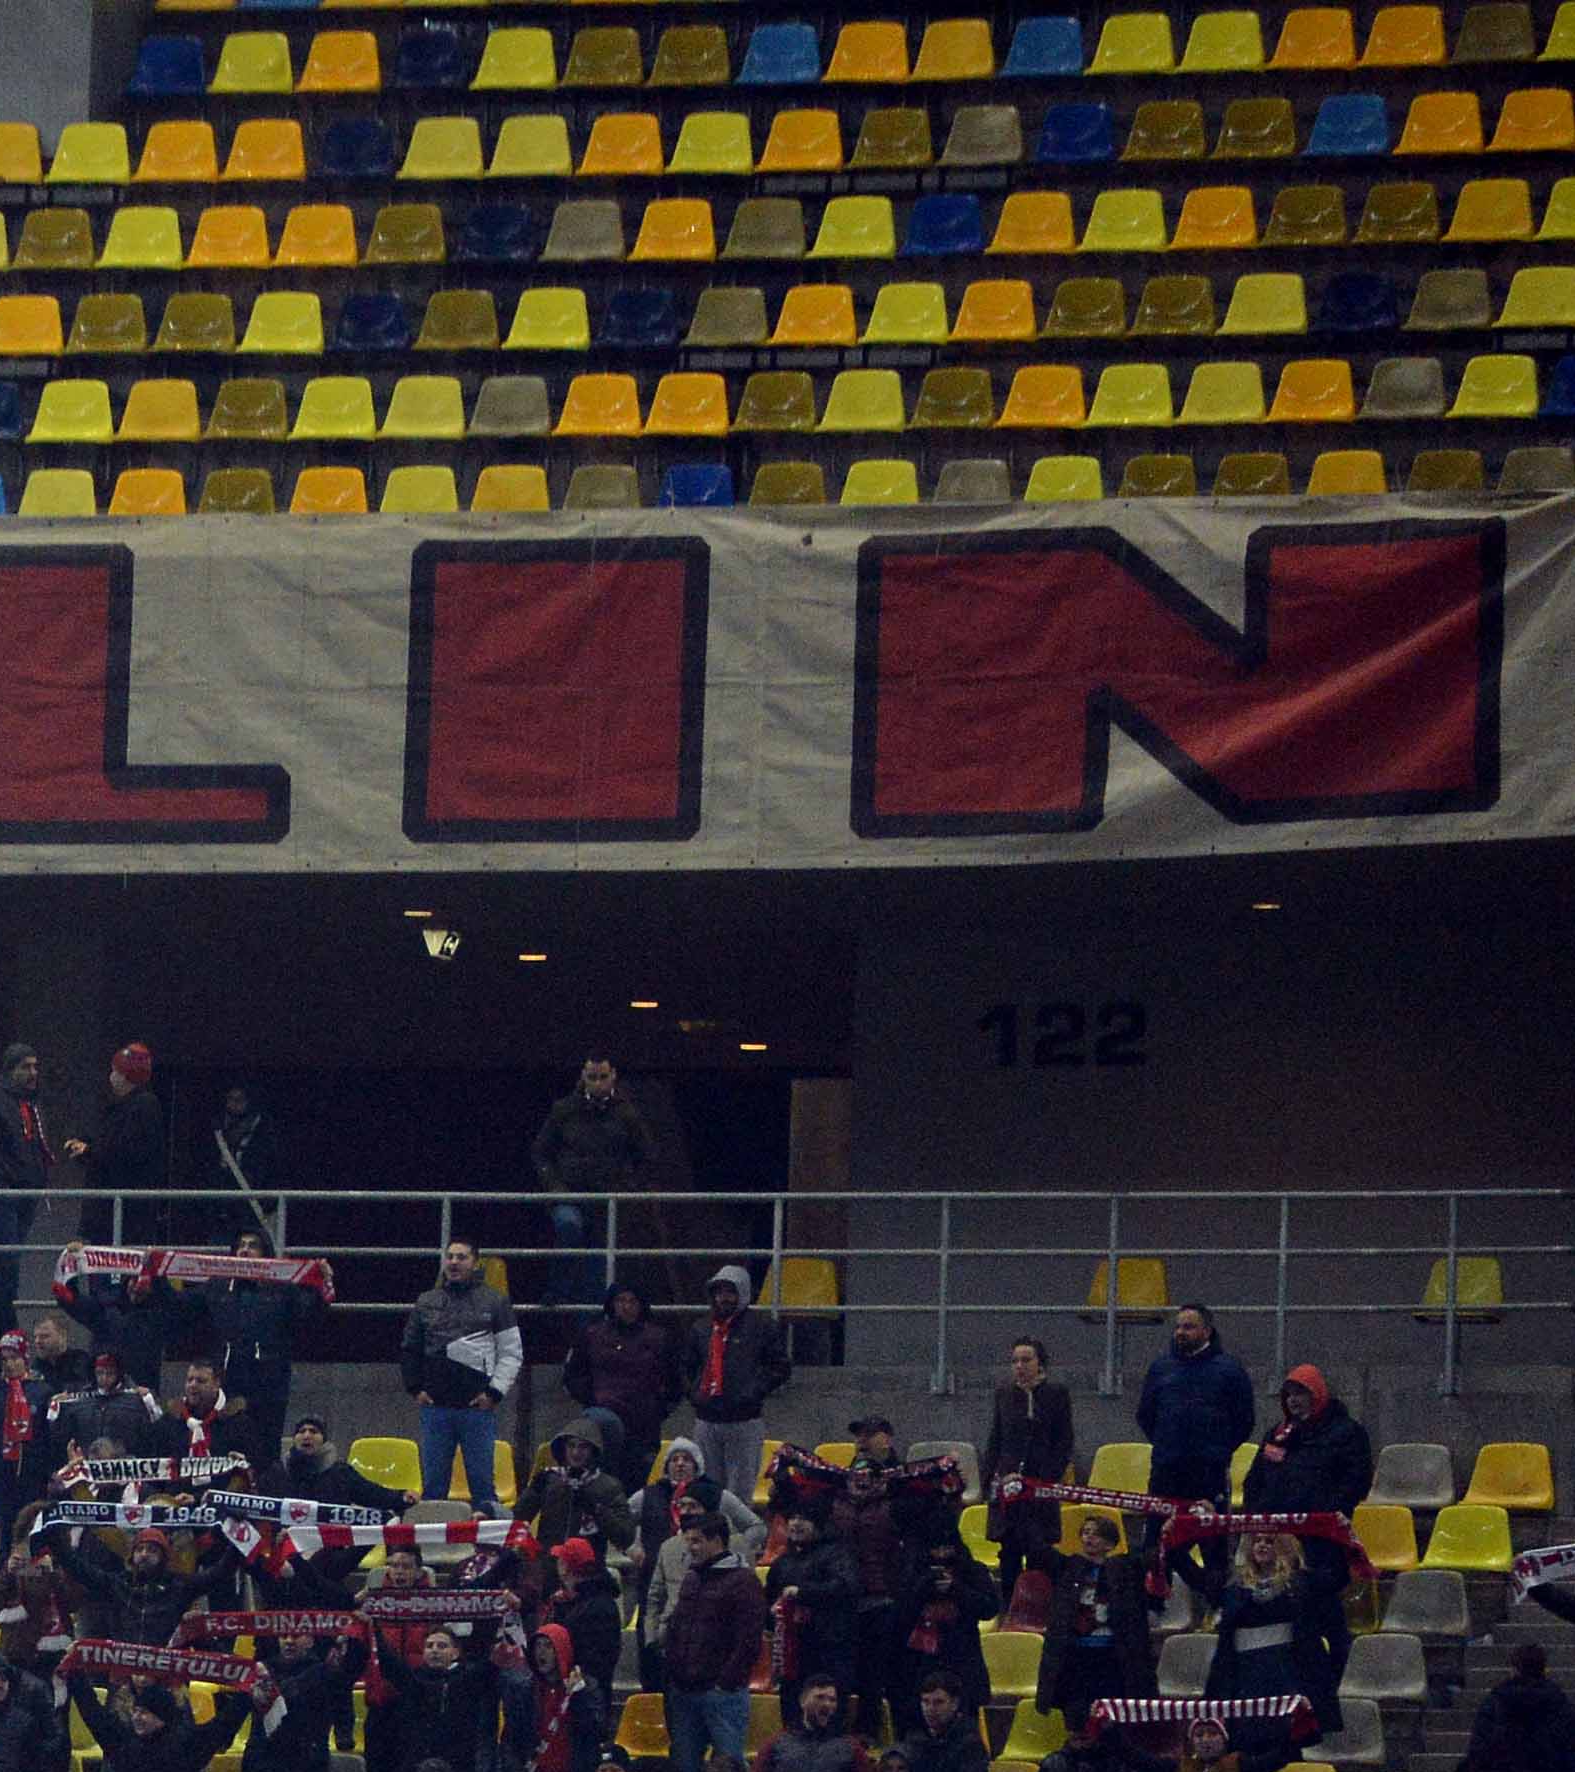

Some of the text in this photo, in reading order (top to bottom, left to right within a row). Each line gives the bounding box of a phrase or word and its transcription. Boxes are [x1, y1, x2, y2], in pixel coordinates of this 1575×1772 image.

[979, 1000, 1148, 1066] 122
[86, 1248, 142, 1269] DINAMO
[48, 1503, 217, 1524] DINAMO 1948
[213, 1493, 384, 1525] DINAMO 1948
[205, 1615, 354, 1630] F.C. DINAMO
[79, 1645, 250, 1682] TINERETULUI
